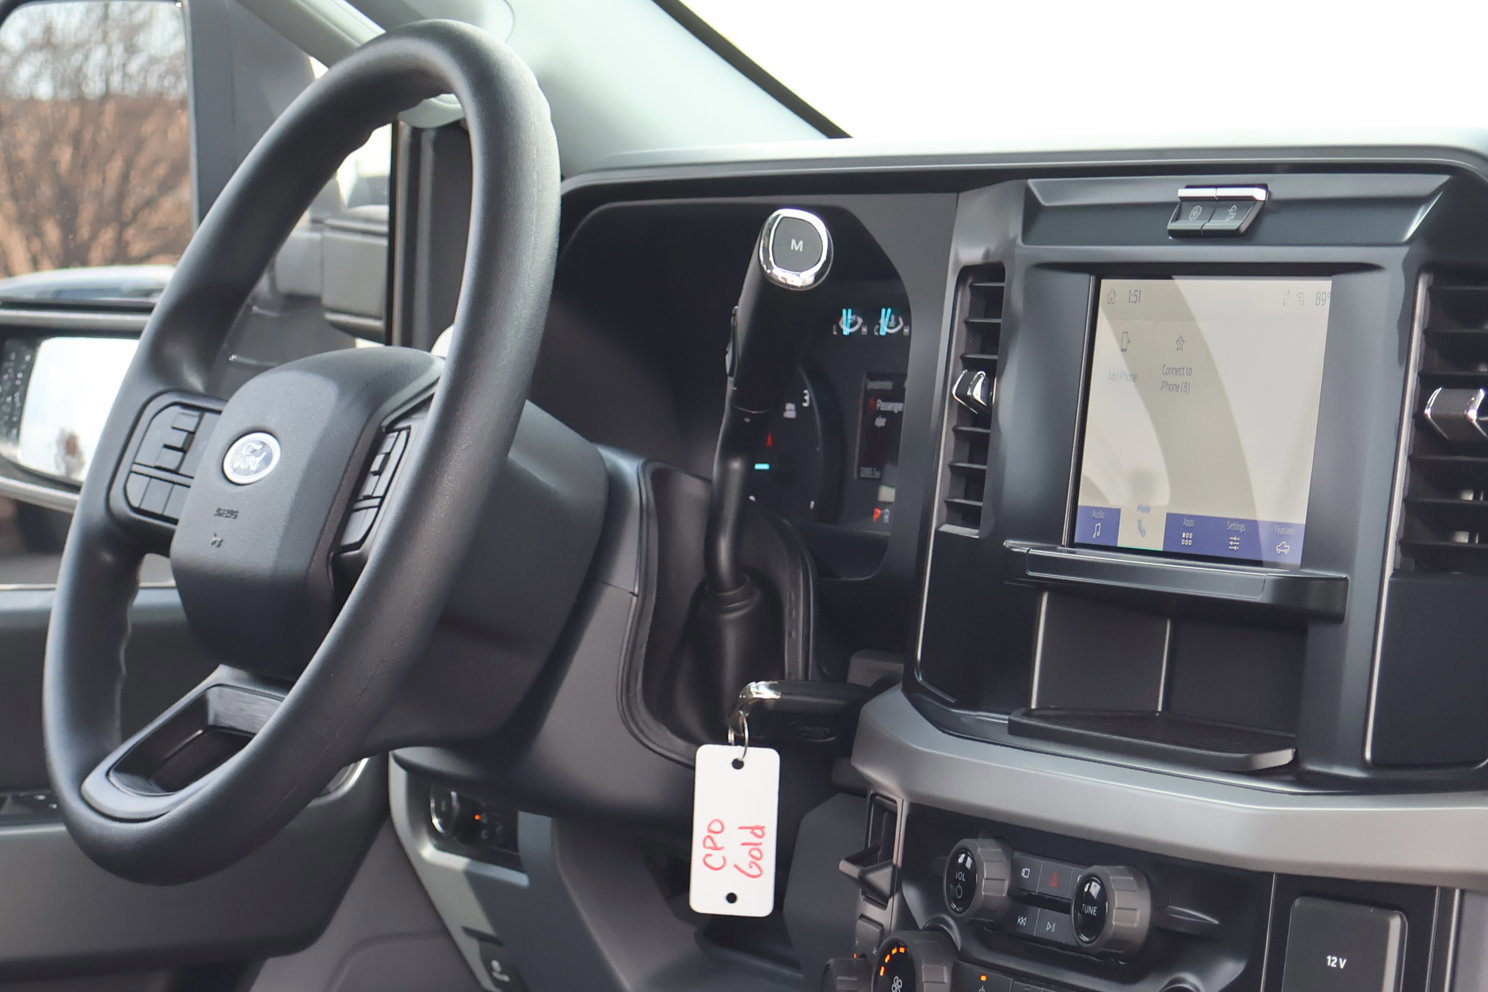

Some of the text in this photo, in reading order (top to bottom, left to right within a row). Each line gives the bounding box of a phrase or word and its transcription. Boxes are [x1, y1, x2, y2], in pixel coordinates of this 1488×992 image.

[790, 239, 804, 252] M
[1162, 364, 1192, 377] Connect to
[1160, 381, 1180, 393] iPhone
[702, 818, 727, 871] CPO
[734, 825, 766, 878] Gold
[955, 872, 966, 882] VOL
[1081, 904, 1098, 917] TUNE
[1326, 955, 1347, 969] 12 V
